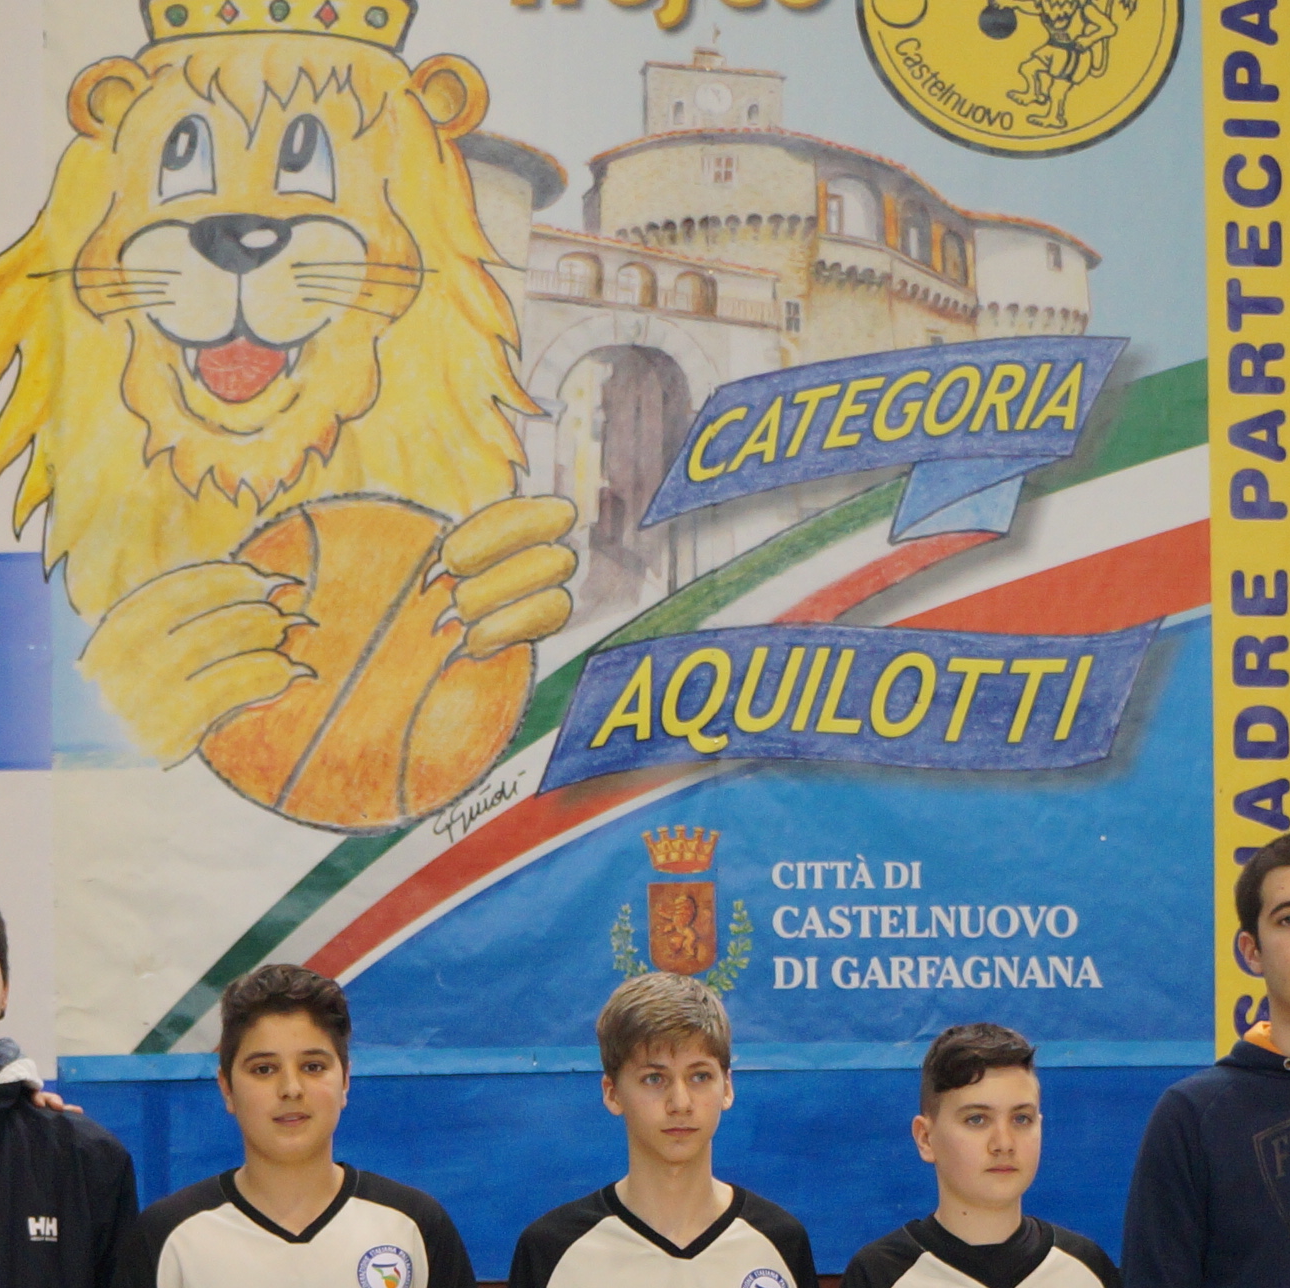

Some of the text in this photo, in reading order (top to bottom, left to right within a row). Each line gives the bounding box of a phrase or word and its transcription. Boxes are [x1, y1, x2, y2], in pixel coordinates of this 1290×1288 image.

[895, 37, 1013, 131] Castelnuovo
[686, 360, 1087, 485] CATEGORIA
[589, 644, 1094, 755] AQUILOTTI
[771, 853, 922, 890] CITTÀ DI
[771, 904, 1080, 939] CASTELNUOVO
[772, 955, 1104, 990] DI GARFAGNANA
